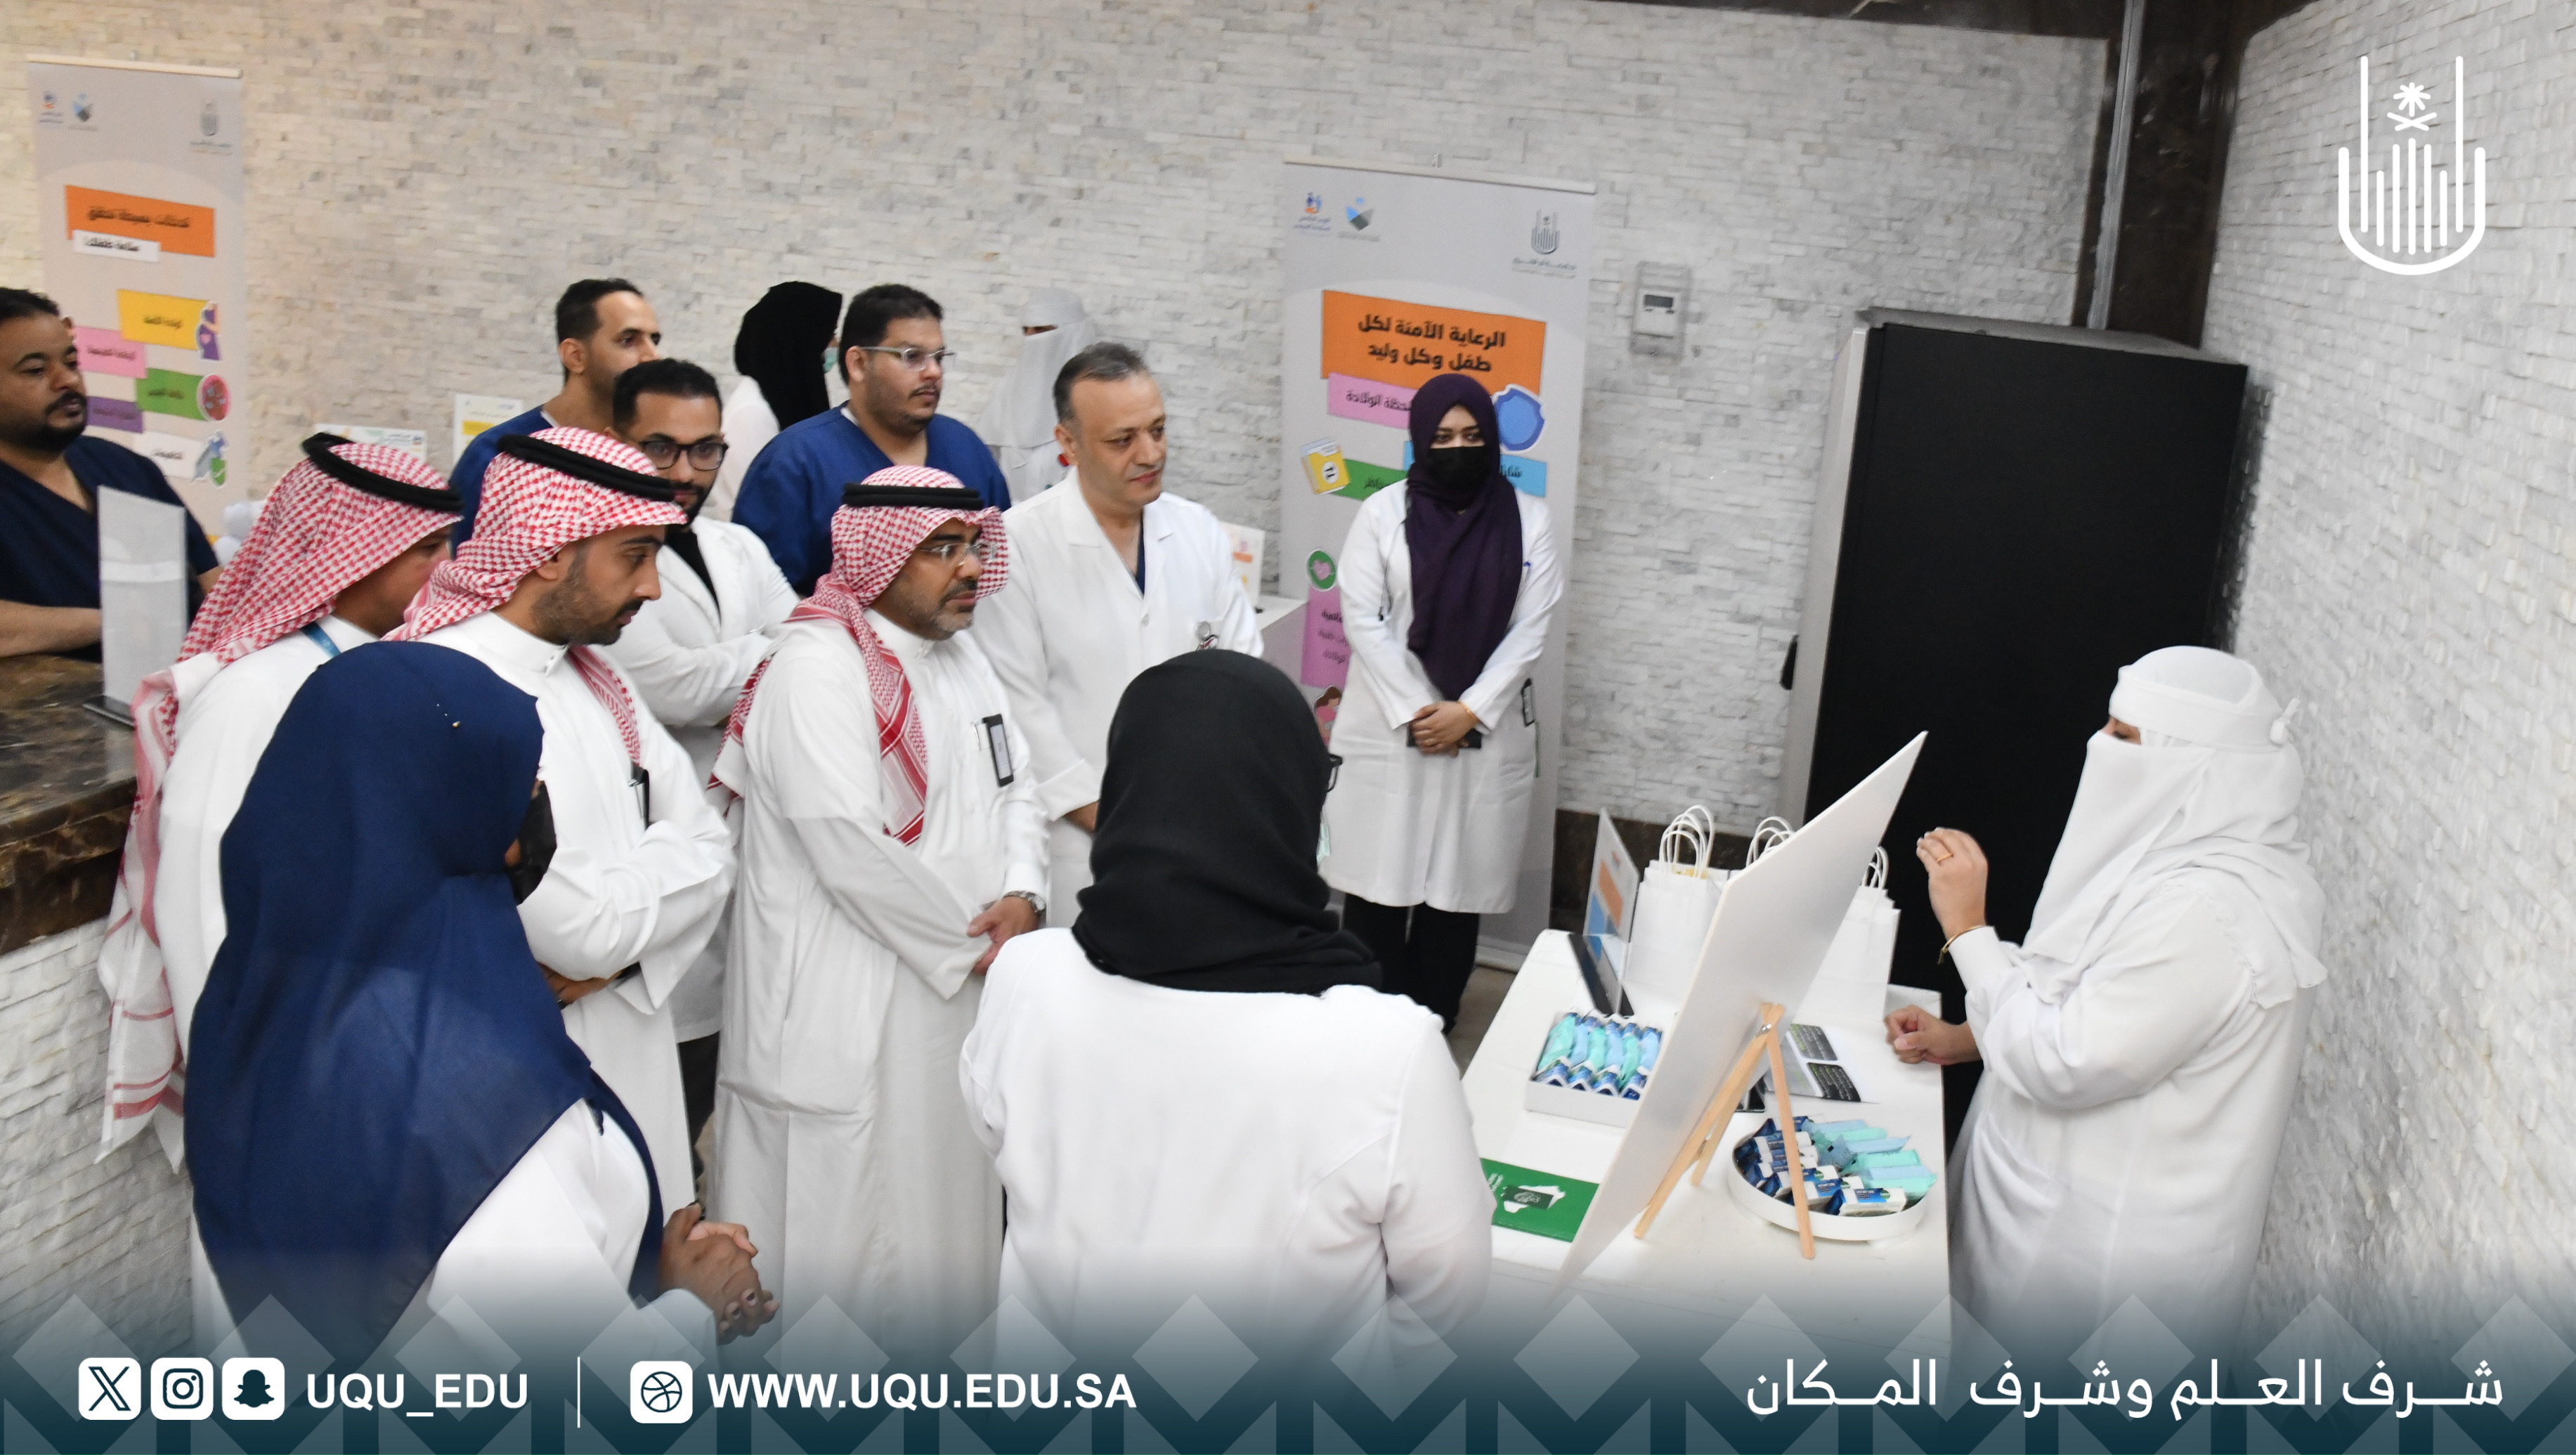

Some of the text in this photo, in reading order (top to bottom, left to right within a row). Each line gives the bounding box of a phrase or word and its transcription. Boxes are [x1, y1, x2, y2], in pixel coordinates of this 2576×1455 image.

[1358, 314, 1506, 350] الرعاية الآمنة لكل
[1368, 342, 1491, 372] طفل وكل وليد
[1346, 390, 1411, 411] حظة الولادة
